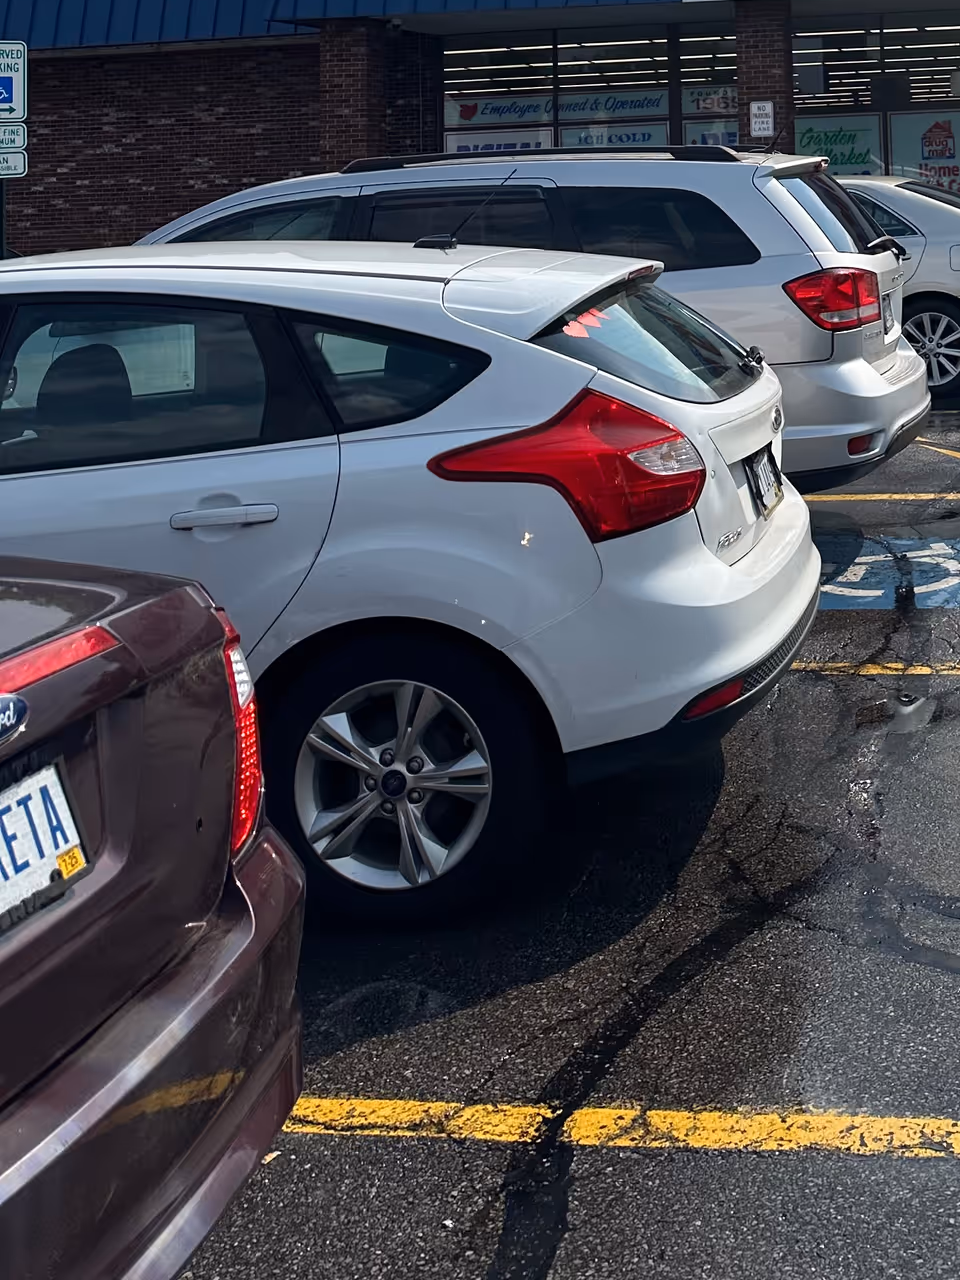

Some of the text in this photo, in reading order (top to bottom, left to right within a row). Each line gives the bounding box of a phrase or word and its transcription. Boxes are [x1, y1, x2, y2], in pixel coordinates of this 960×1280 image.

[480, 101, 541, 118] Employee
[589, 96, 602, 112] &
[603, 93, 664, 112] Operated
[756, 104, 767, 112] NO
[607, 132, 652, 144] COLD
[800, 126, 857, 149] Garden
[918, 163, 960, 179] Home
[0, 783, 70, 882] ETA
